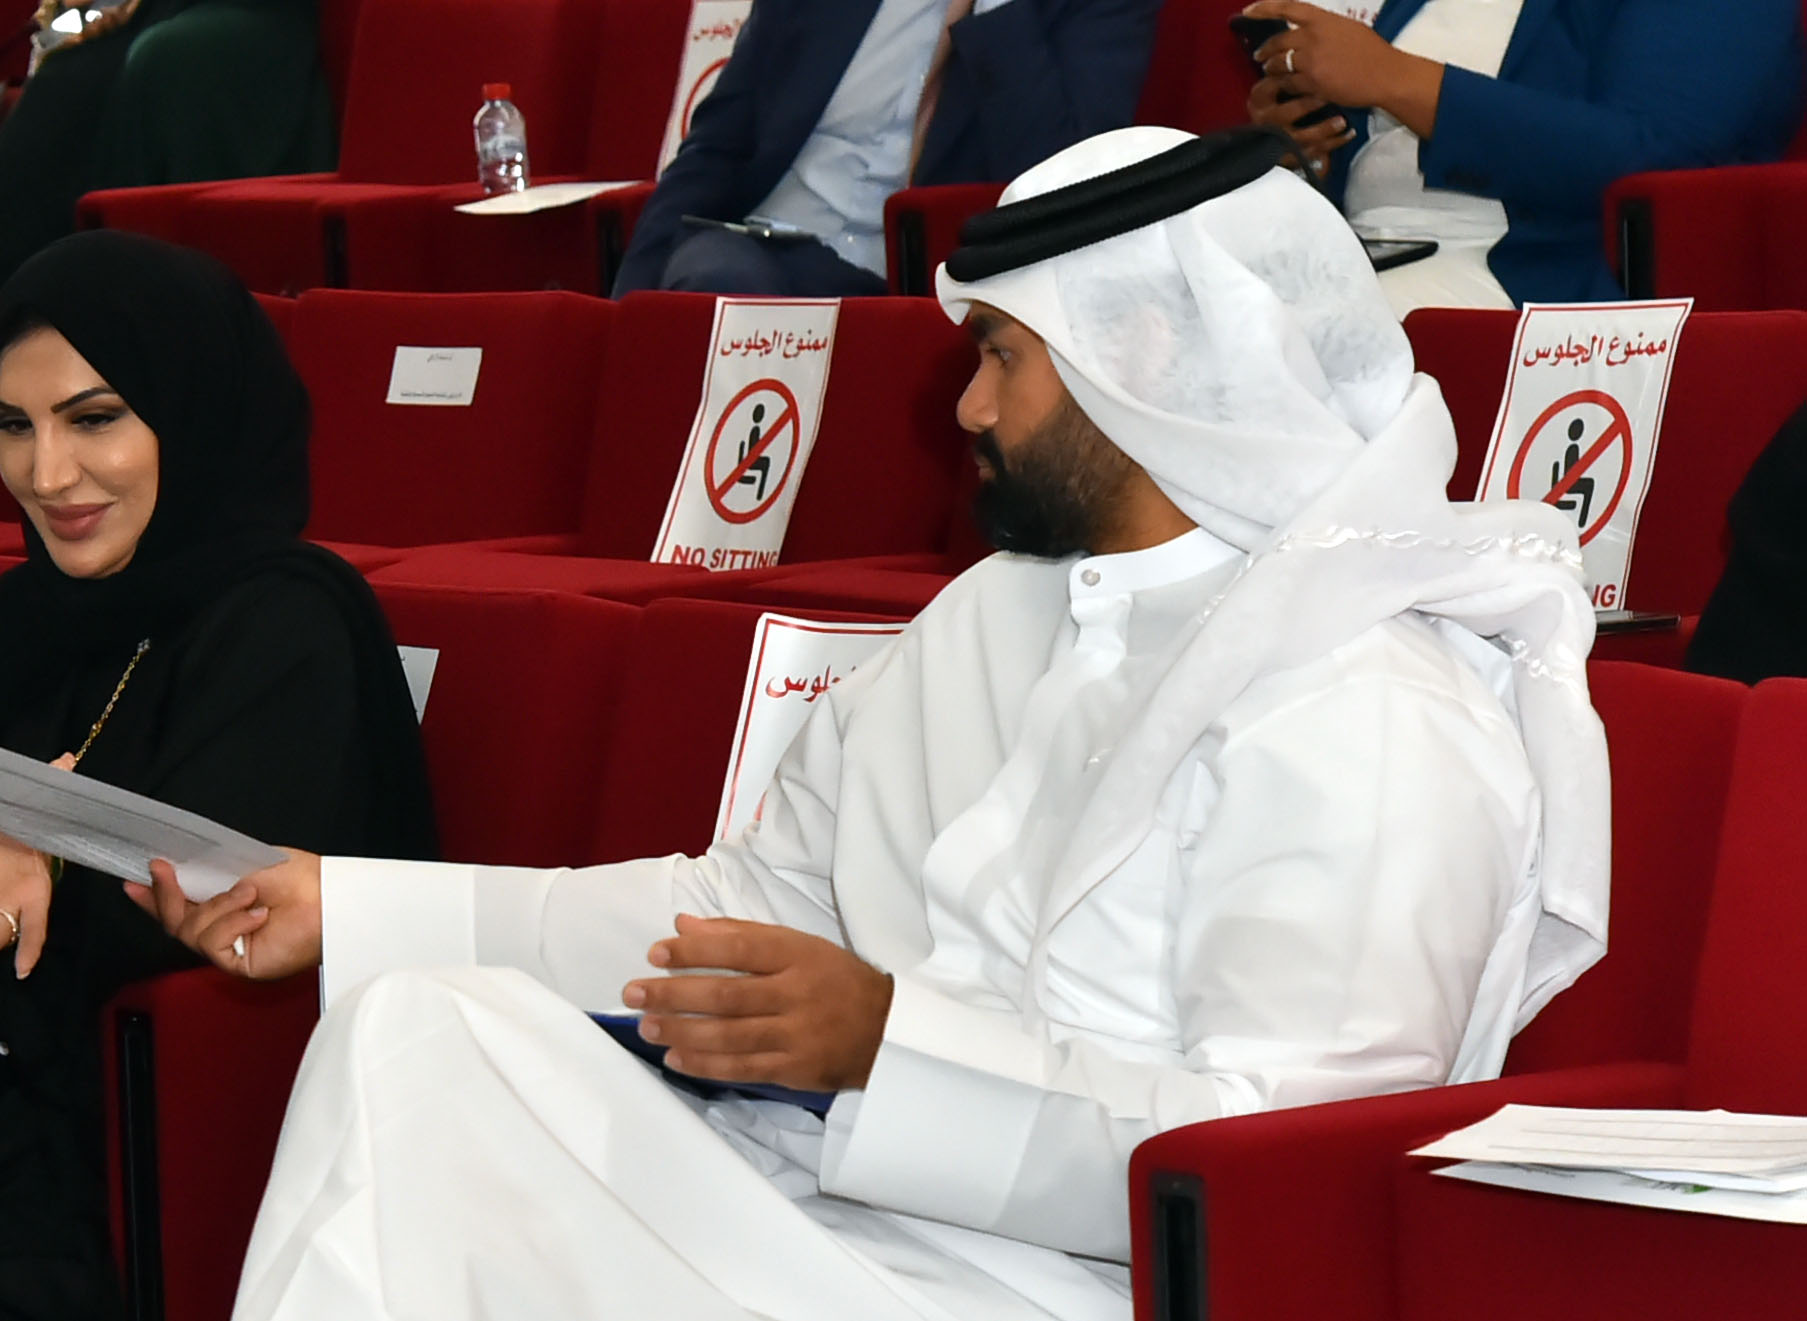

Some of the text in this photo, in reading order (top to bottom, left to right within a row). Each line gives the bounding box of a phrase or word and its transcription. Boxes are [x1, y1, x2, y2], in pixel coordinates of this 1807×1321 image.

[720, 329, 828, 358] ممنوع الجلوس
[1522, 332, 1668, 368] ممنوع الجلوس
[672, 544, 778, 569] NO SITTING
[765, 664, 856, 703] لوس
